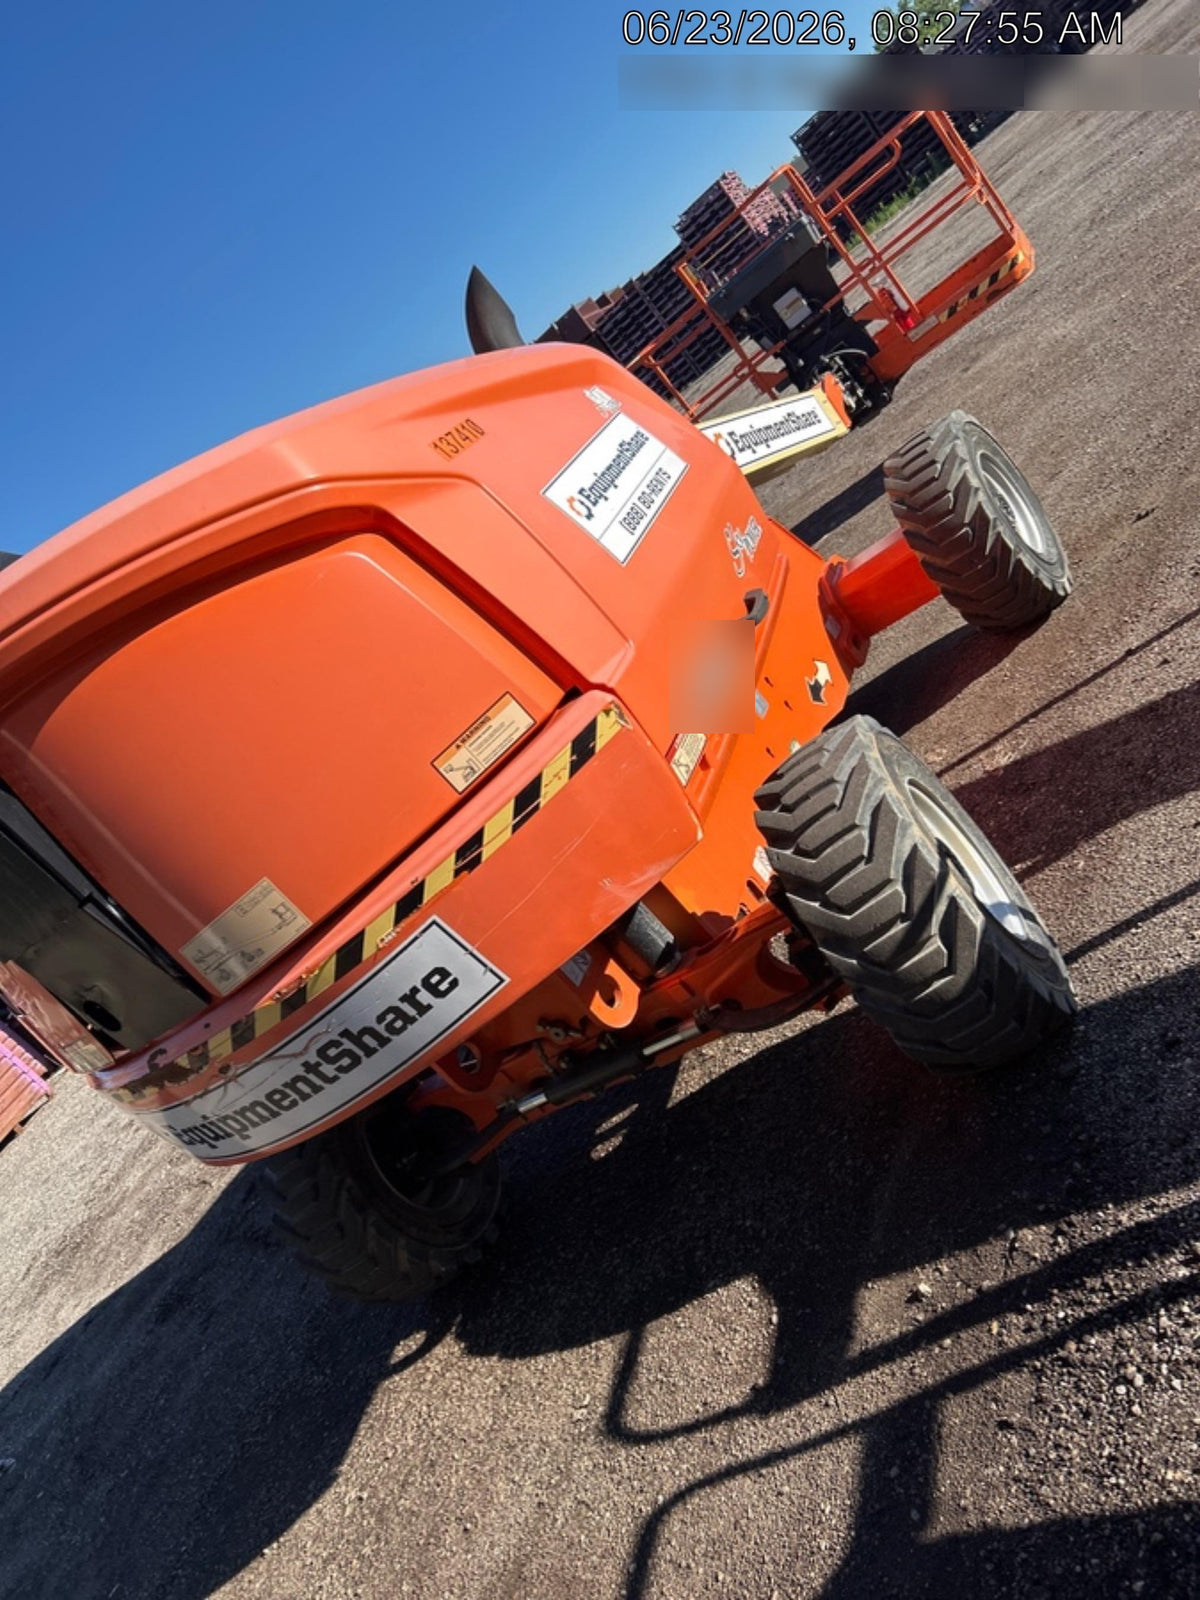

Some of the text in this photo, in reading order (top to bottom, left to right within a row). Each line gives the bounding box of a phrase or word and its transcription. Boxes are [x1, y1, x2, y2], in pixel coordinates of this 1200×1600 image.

[432, 418, 485, 459] 137410
[727, 409, 822, 455] EquipmentShare
[577, 429, 650, 507] EquipmentShare
[172, 966, 460, 1149] EquipmentShare
